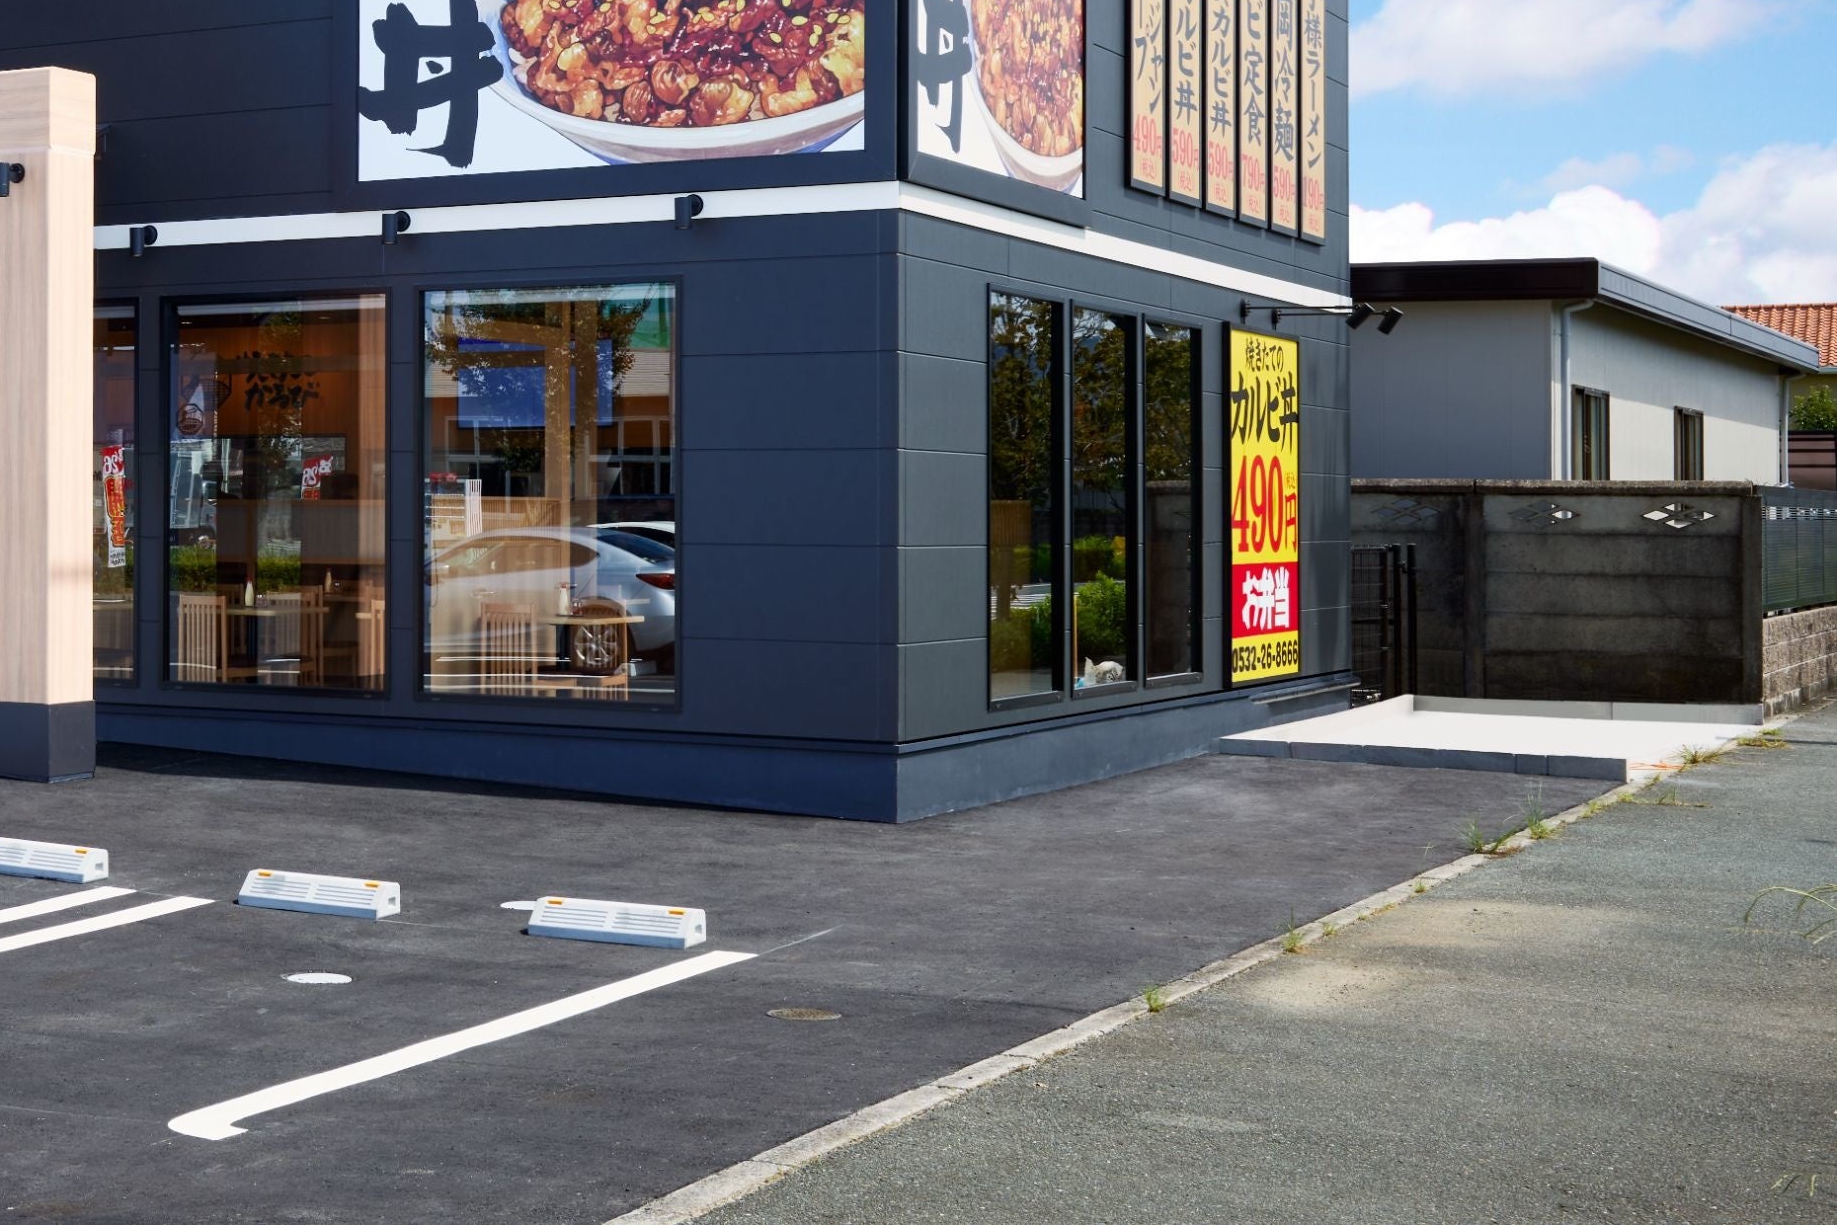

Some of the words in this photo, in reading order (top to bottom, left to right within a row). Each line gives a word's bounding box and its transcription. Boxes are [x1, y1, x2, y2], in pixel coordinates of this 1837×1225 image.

[1245, 336, 1284, 372] 焼きたての
[1231, 371, 1299, 455] カルビ丼
[1231, 454, 1297, 554] 490円
[1241, 566, 1290, 631] お弁当
[1231, 639, 1299, 675] 0532-26-8666
